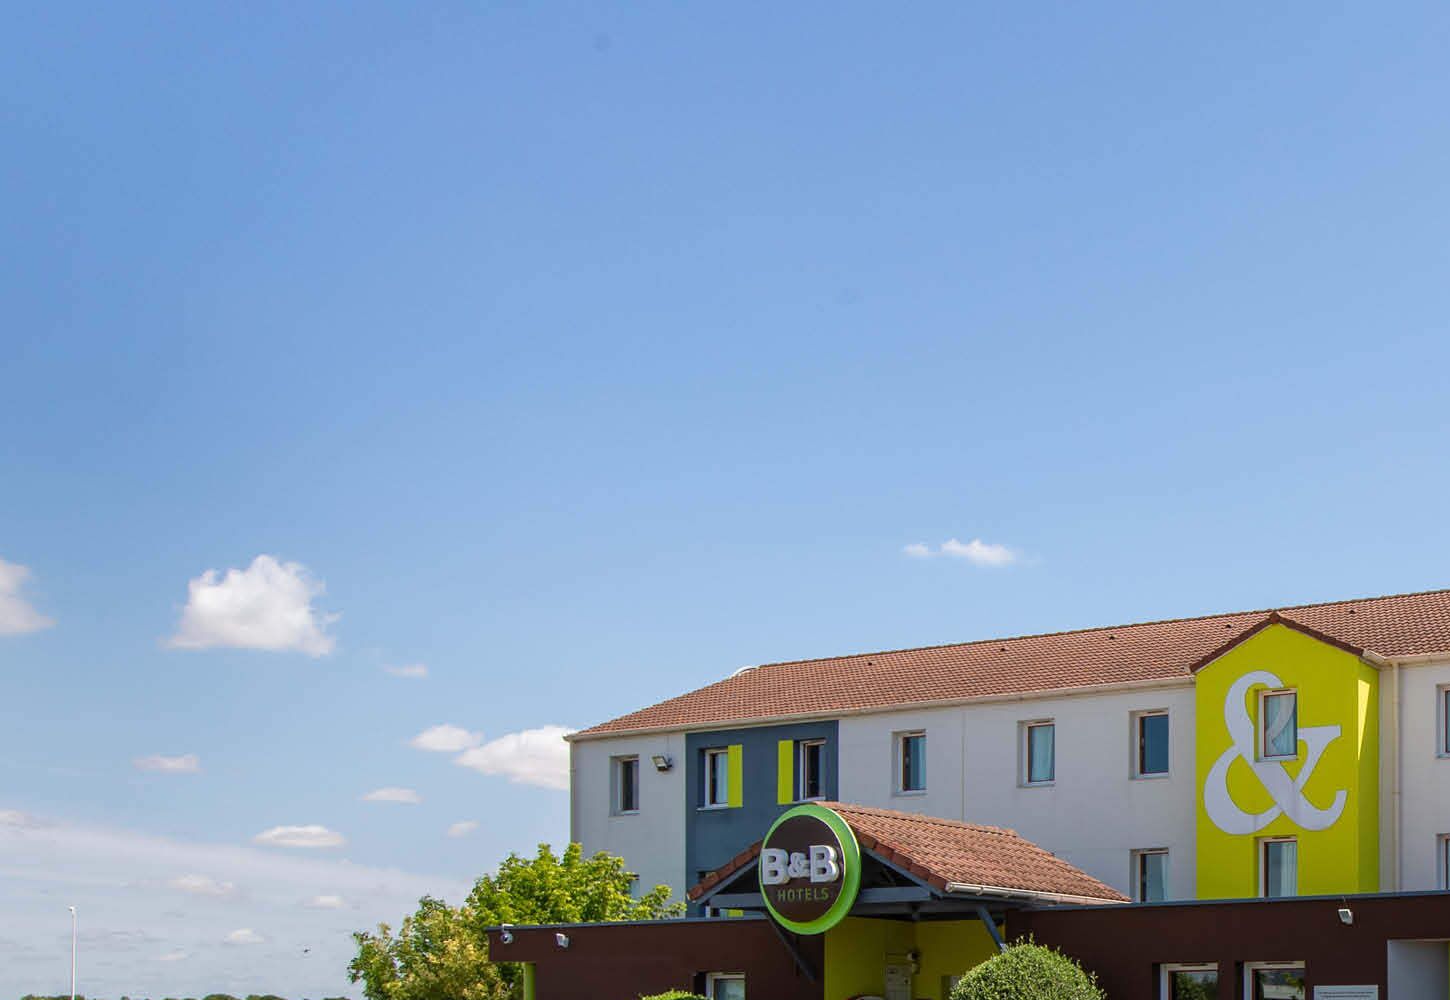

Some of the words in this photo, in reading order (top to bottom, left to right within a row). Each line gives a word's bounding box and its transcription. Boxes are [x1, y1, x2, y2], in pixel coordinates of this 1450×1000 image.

[1203, 670, 1348, 836] &
[761, 844, 840, 885] B&B
[777, 886, 830, 901] HOTELS
